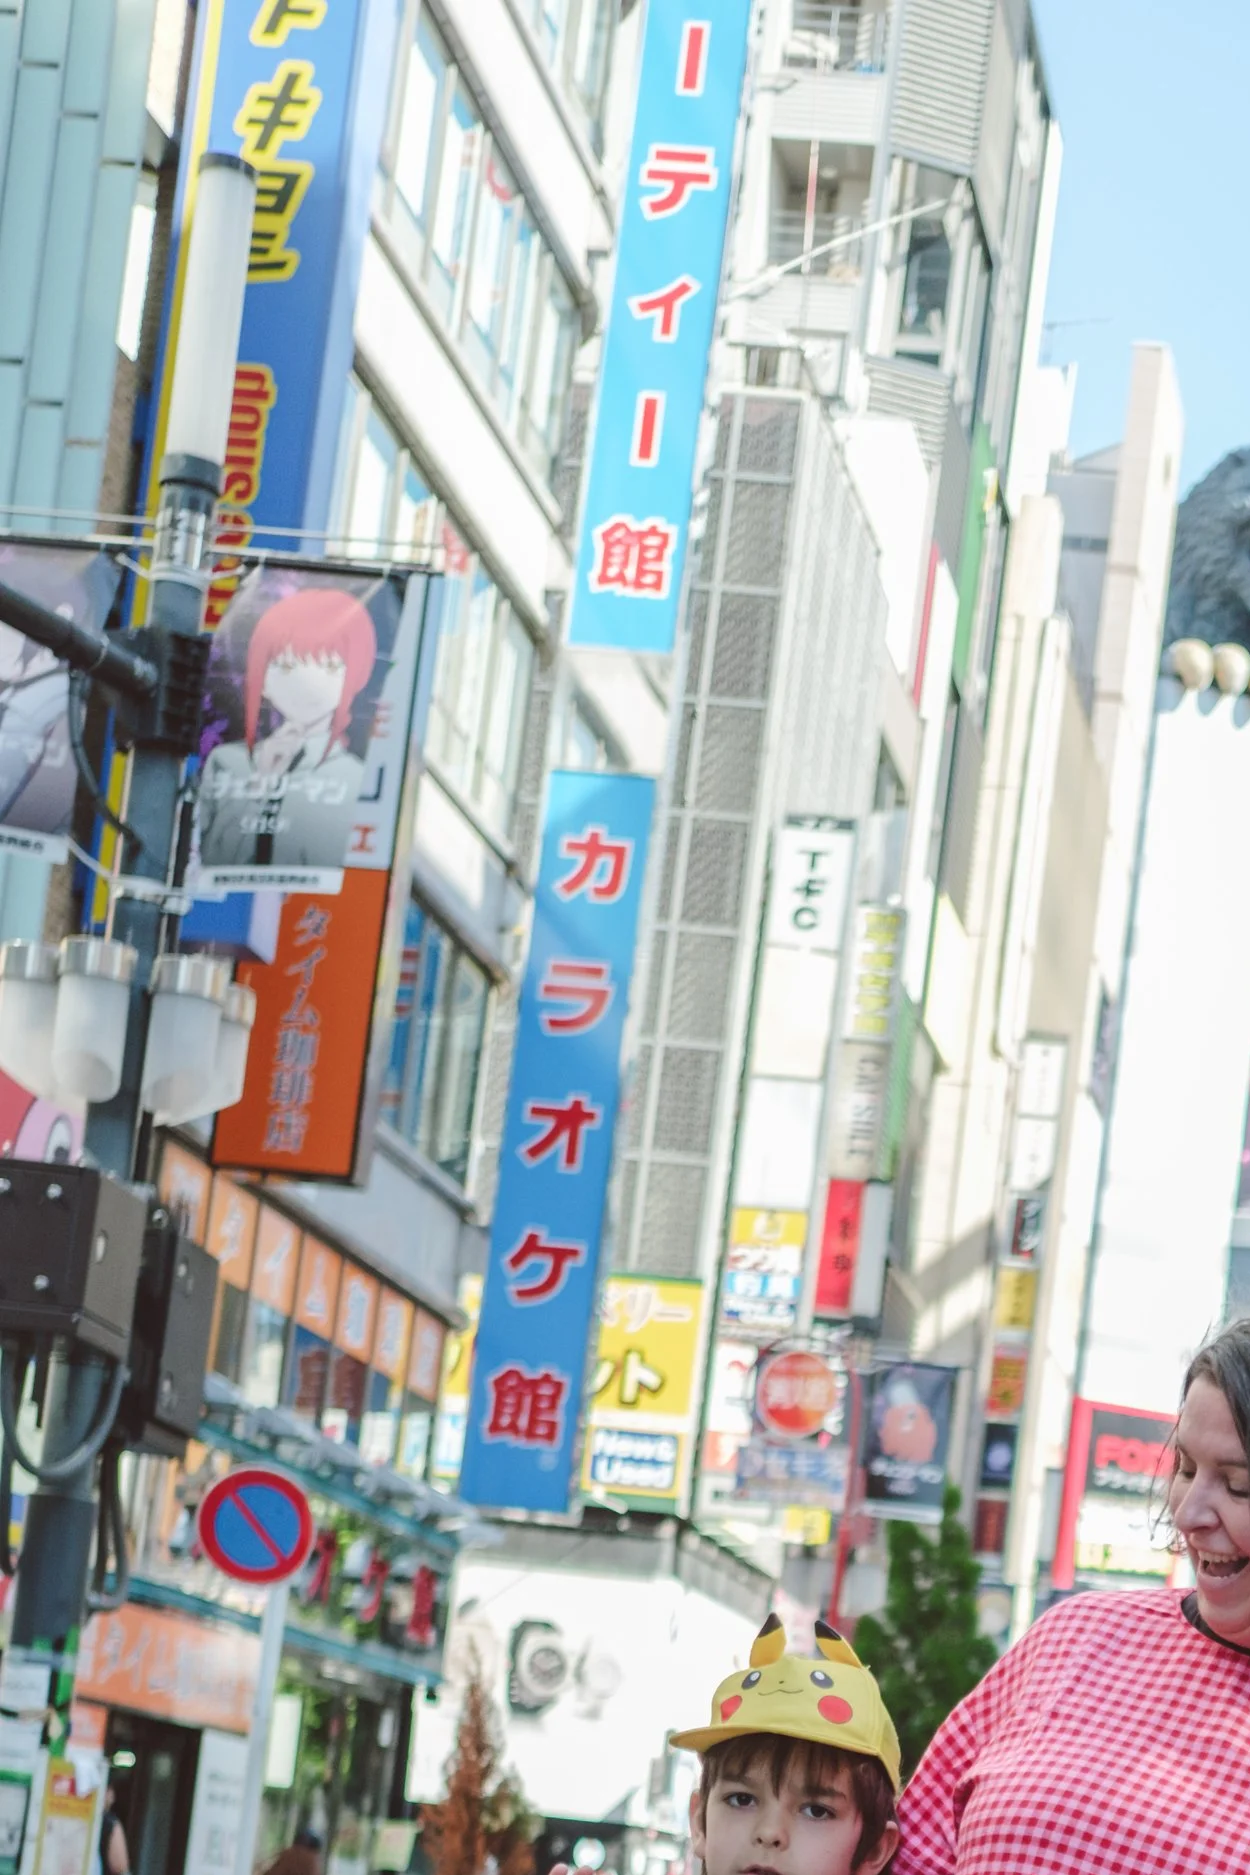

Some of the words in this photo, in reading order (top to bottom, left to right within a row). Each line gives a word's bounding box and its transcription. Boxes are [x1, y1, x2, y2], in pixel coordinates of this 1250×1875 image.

[484, 825, 635, 1448] カラオケ館
